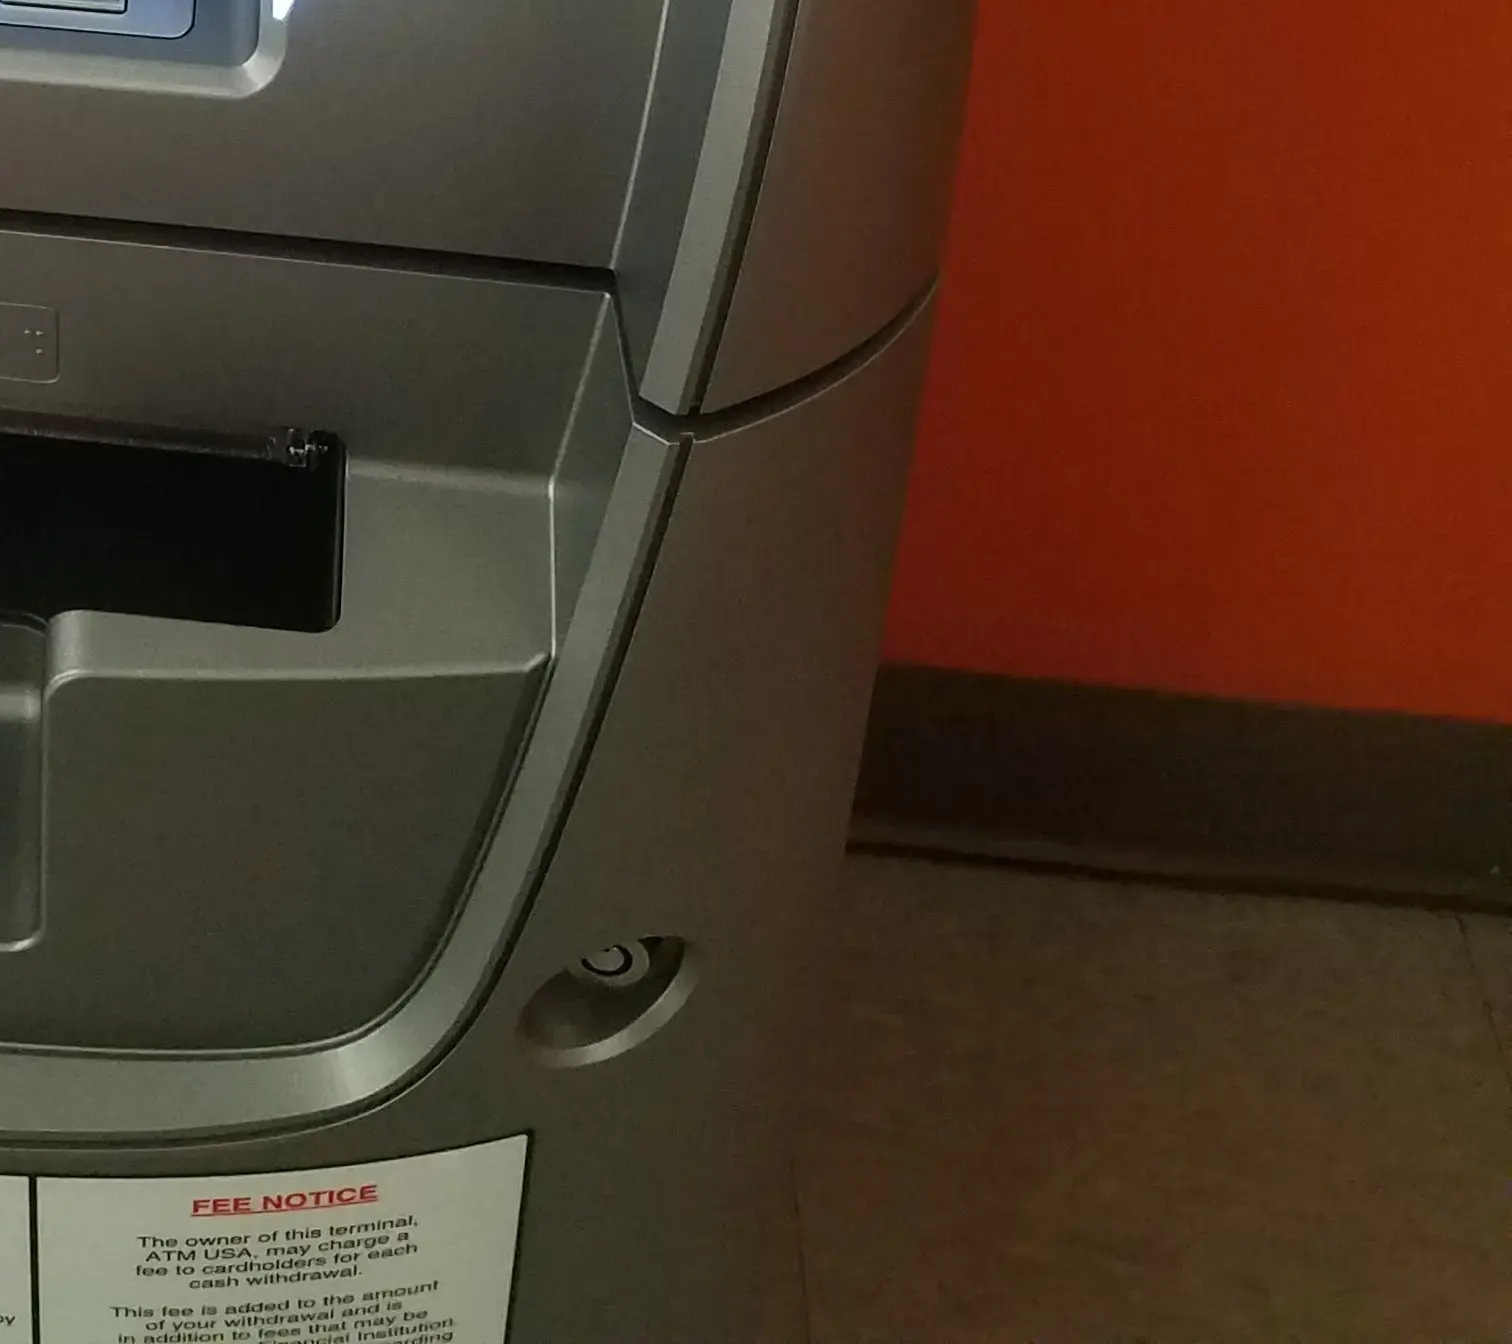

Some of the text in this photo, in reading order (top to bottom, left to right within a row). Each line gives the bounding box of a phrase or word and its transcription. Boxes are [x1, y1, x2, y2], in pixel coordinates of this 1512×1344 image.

[192, 1184, 379, 1213] FEE NOTICE
[137, 1215, 418, 1248] The owner of this terminal,
[145, 1231, 409, 1262] ATM USA, may charge a
[136, 1243, 418, 1277] fee to cardholders for each
[188, 1263, 363, 1289] cash withdrawal.
[109, 1280, 440, 1318] This fee is added to the amount
[143, 1331, 225, 1344] addition
[232, 1331, 252, 1341] to
[258, 1327, 301, 1339] fees
[308, 1320, 347, 1334] that
[353, 1315, 396, 1330] may
[403, 1310, 428, 1322] be
[145, 1300, 403, 1332] of your withdrawal and is
